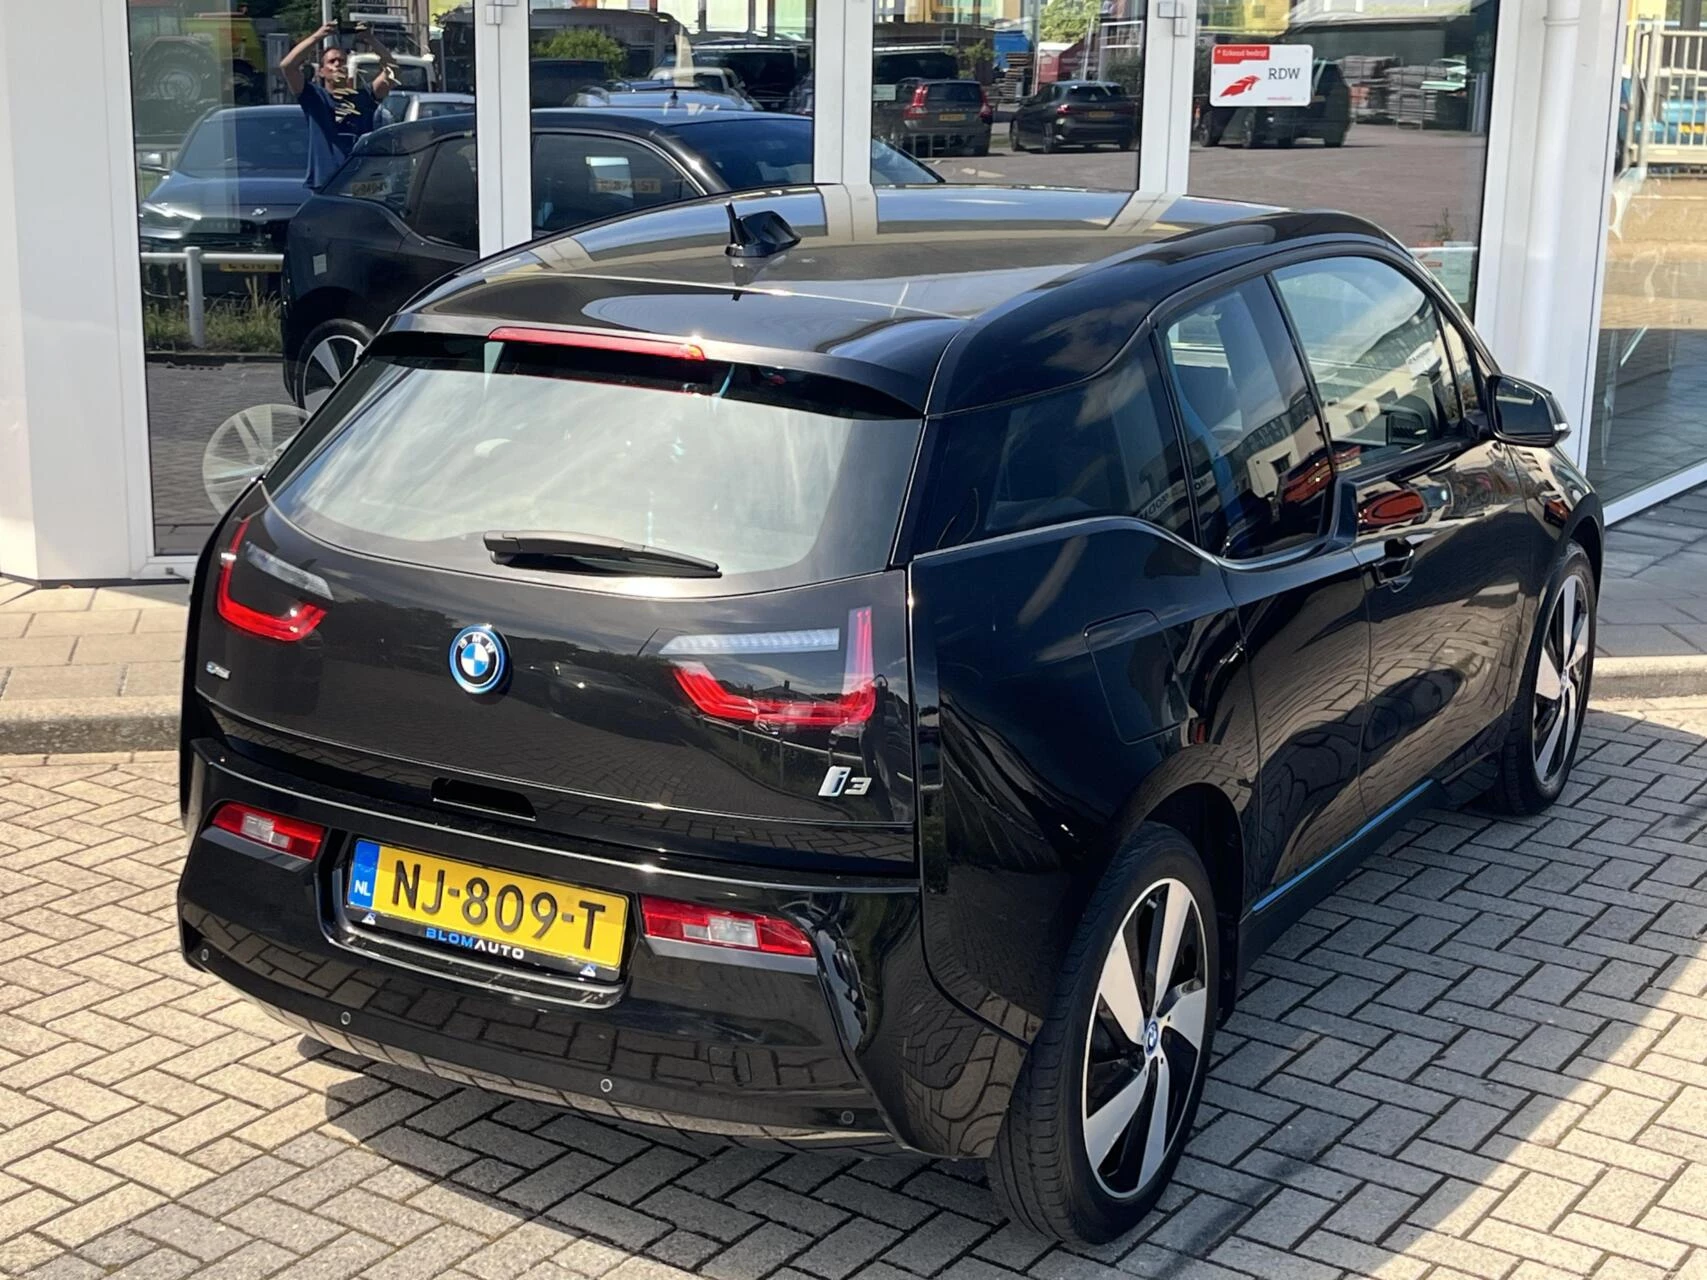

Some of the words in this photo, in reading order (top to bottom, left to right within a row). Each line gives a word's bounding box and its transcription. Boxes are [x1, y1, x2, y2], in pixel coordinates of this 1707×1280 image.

[1268, 68, 1300, 80] RDW
[458, 633, 496, 654] BMW
[818, 765, 872, 797] i3
[354, 879, 371, 897] NL
[391, 860, 606, 950] NJ-809-T
[425, 927, 525, 960] BLOMAUTO
